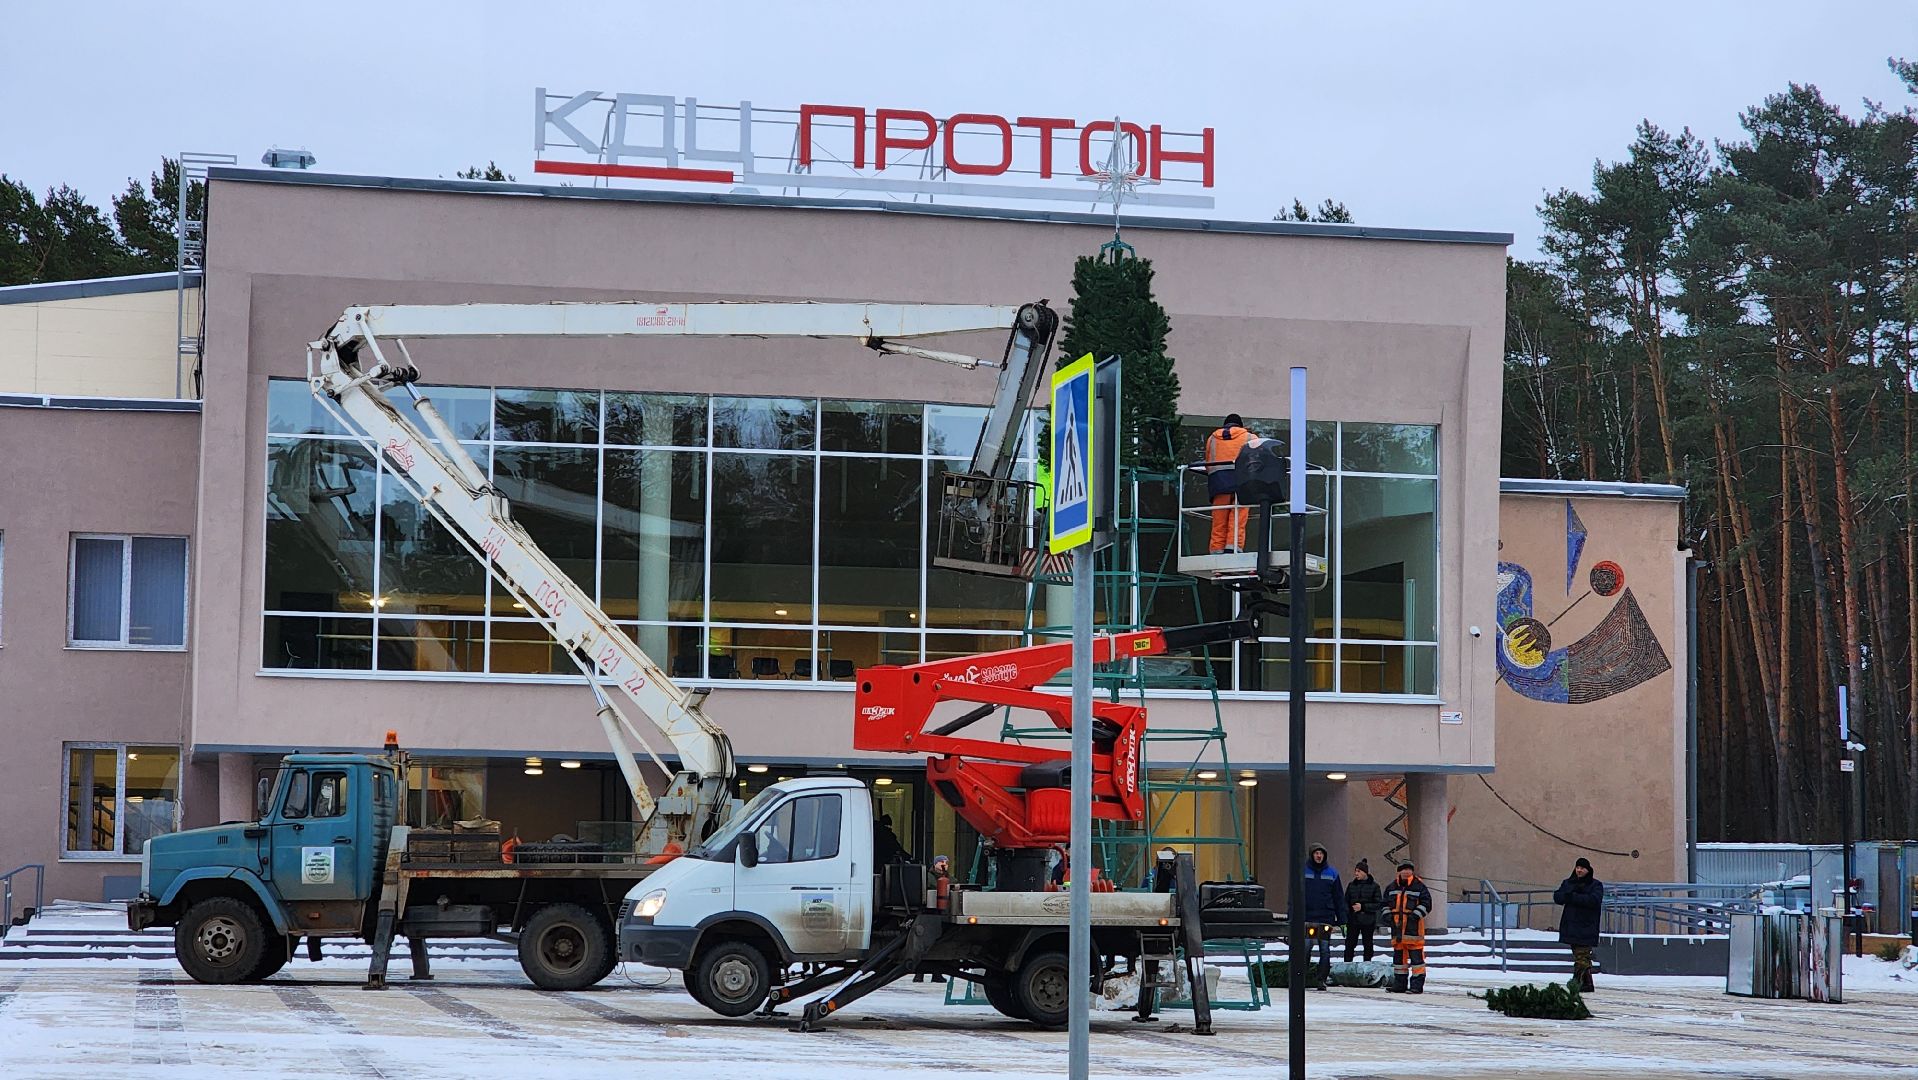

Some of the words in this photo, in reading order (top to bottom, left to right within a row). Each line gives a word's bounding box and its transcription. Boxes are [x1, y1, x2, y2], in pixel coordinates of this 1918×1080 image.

[534, 87, 754, 176] КДЦ
[800, 104, 1215, 188] ПРОТОН
[535, 580, 567, 617] ПСС
